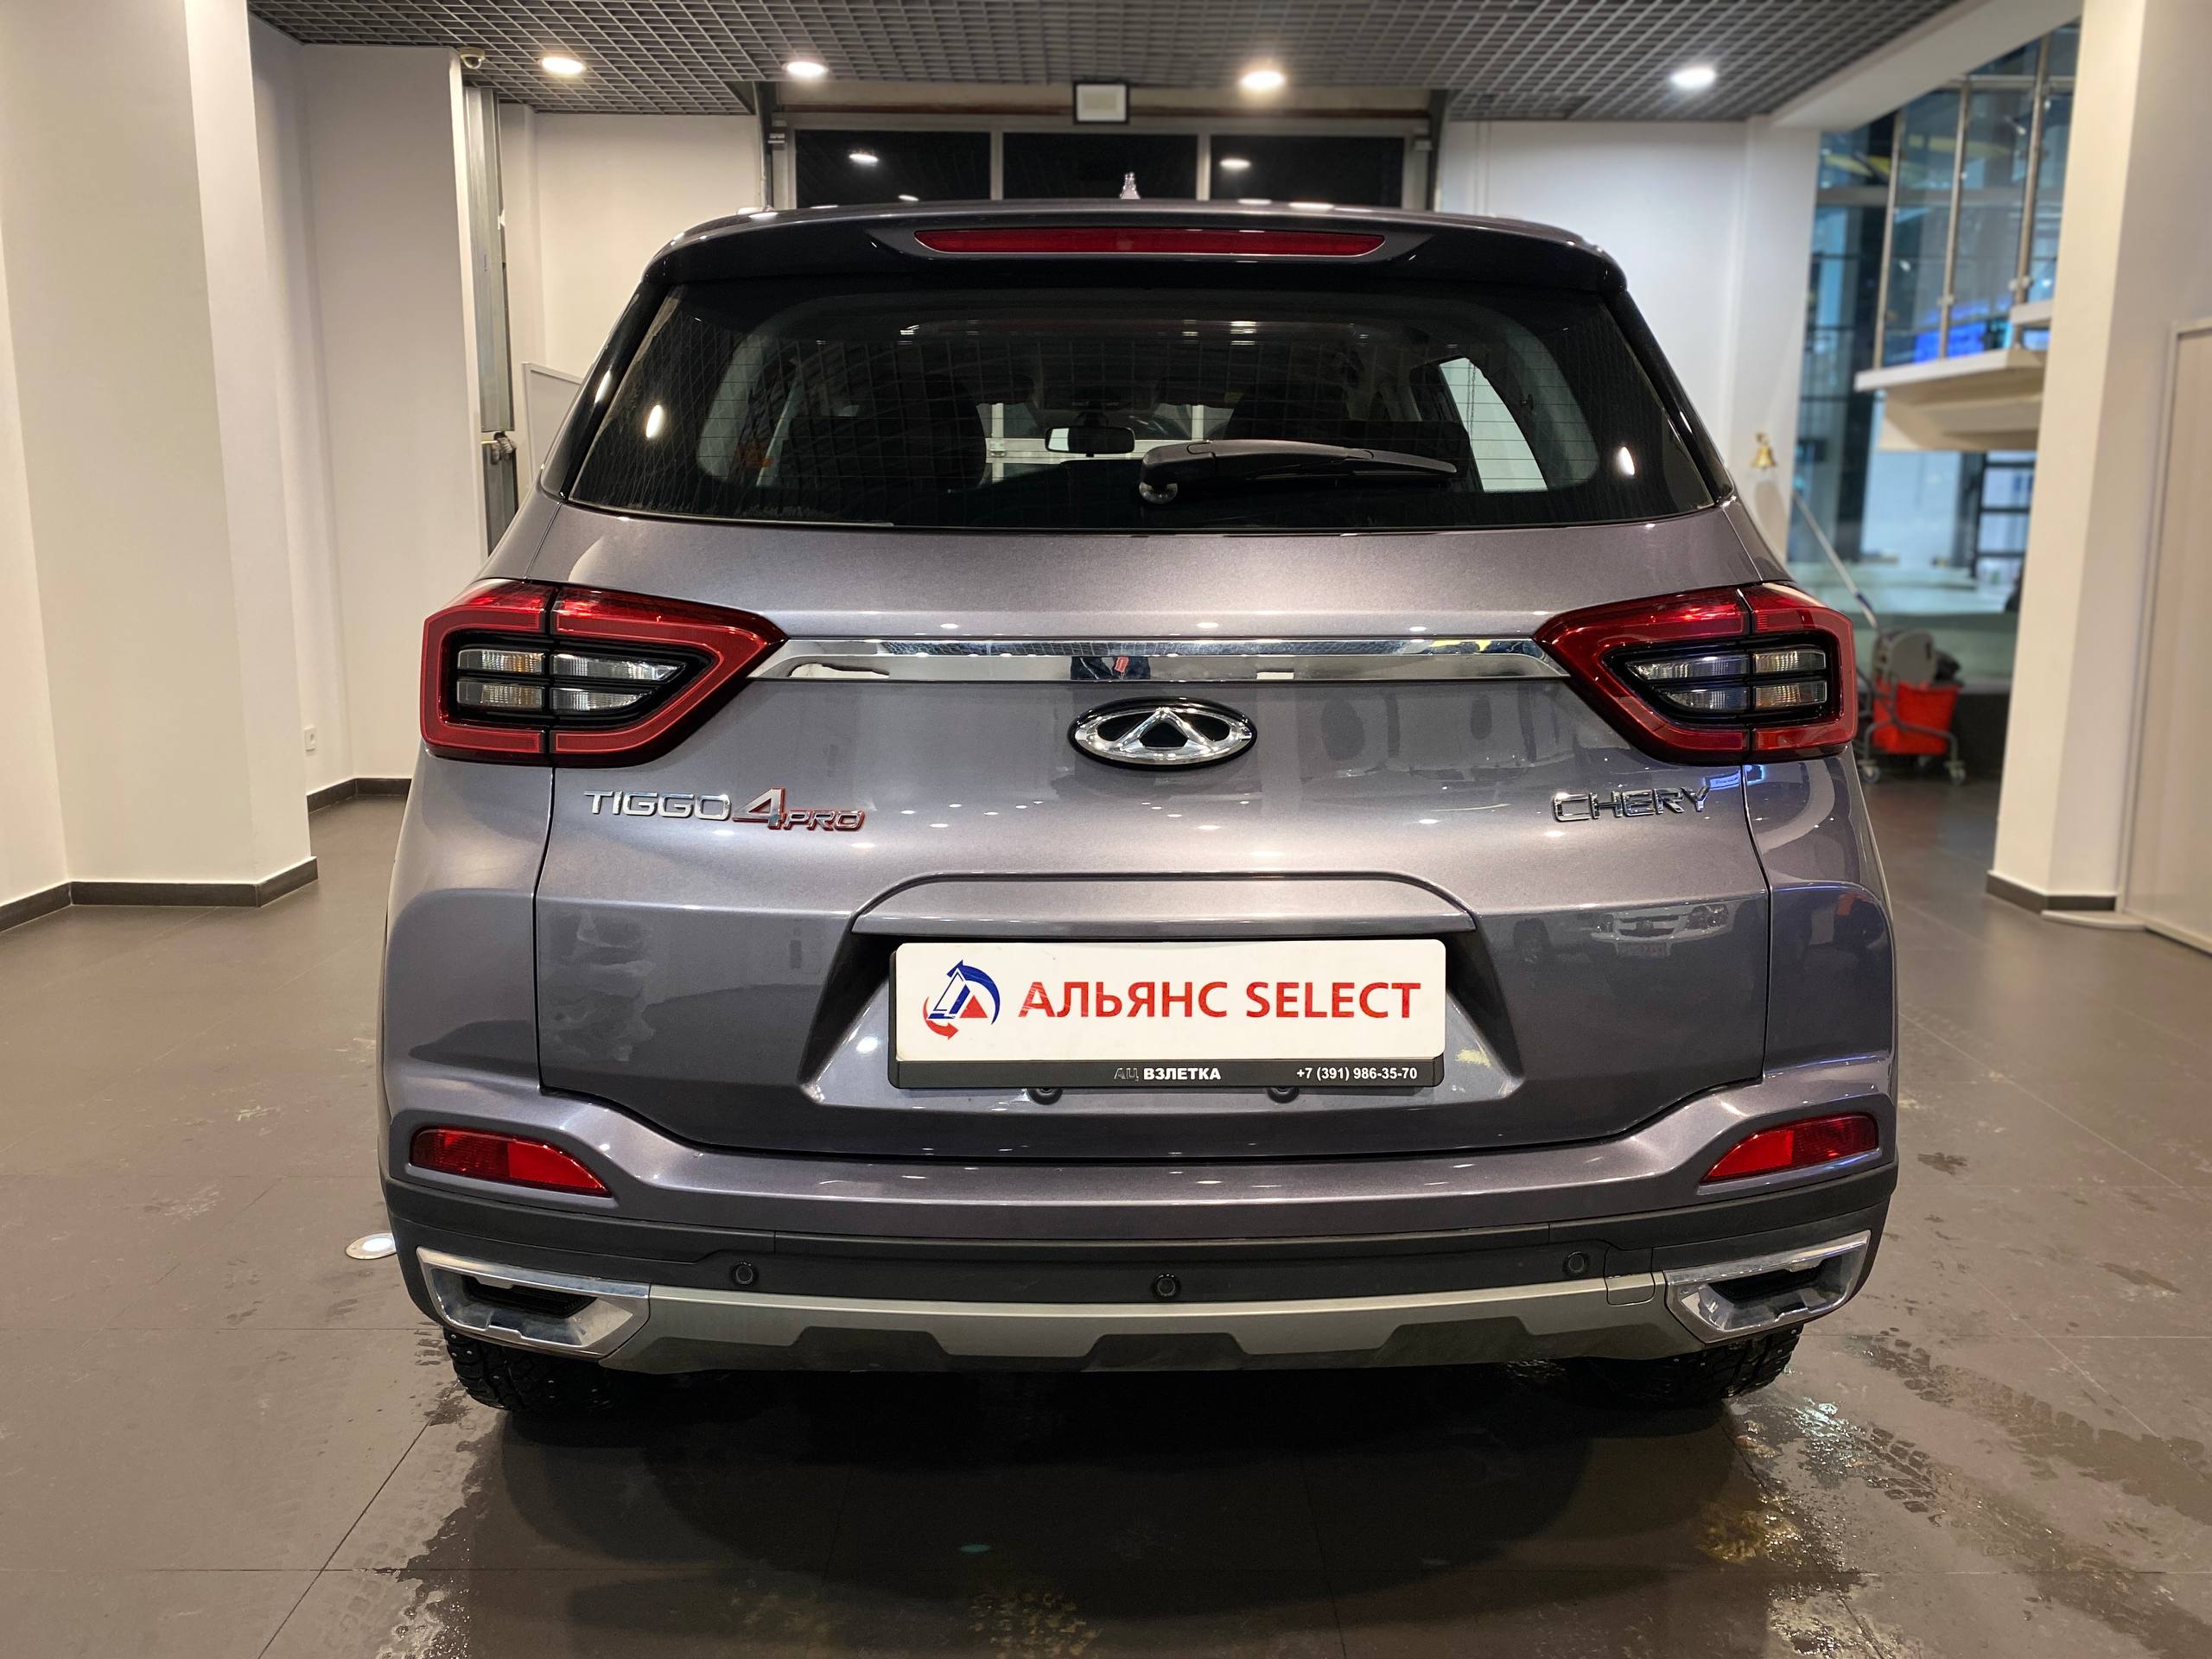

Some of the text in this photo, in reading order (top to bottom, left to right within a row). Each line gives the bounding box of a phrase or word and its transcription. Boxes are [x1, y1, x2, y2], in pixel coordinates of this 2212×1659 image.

[584, 790, 731, 820] TIGGO
[1554, 780, 1710, 822] CHERY
[1018, 981, 1421, 1019] АЛЬЯНС SELECT
[1143, 1067, 1222, 1080] ВЗЛЕТКА
[1296, 1066, 1418, 1081] +7 (391) 986-35-70
